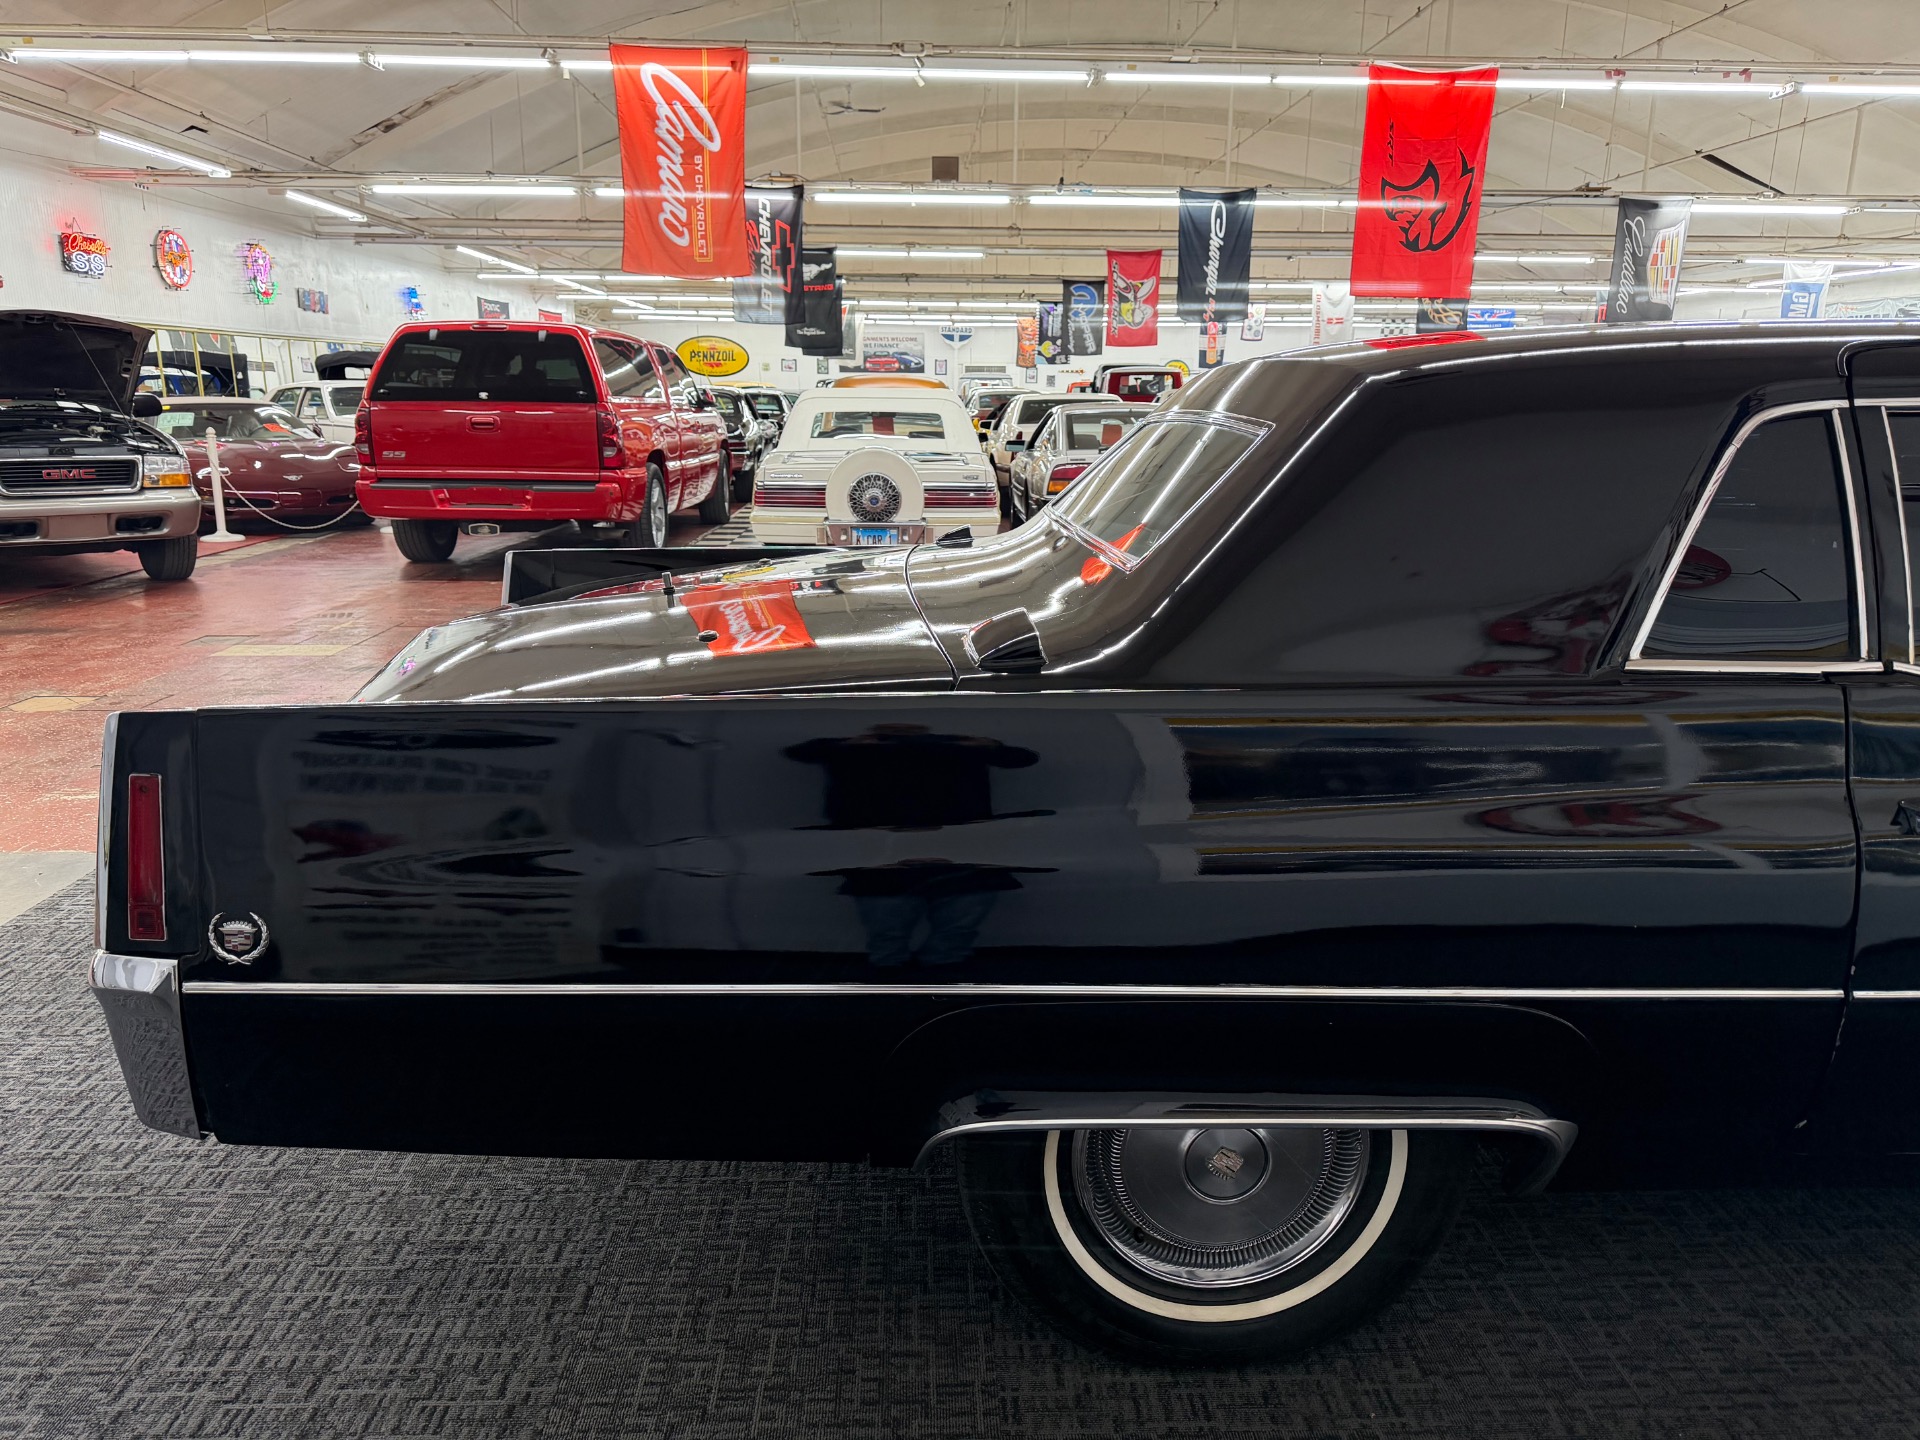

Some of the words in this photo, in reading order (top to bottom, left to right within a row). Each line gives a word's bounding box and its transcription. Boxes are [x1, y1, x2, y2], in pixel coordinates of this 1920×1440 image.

[640, 62, 721, 247] Camaro
[694, 155, 703, 171] BY
[694, 171, 707, 256] CHEVROLET
[68, 233, 107, 255] Chevelle
[165, 233, 183, 246] FORD
[1203, 199, 1227, 296] Charger
[71, 250, 106, 274] SS
[758, 197, 773, 316] CHEVROLET
[1615, 216, 1646, 314] Cadillac
[802, 283, 834, 292] STANG
[1111, 258, 1120, 297] SCAT
[1077, 302, 1098, 354] MOPAR
[1111, 296, 1120, 338] PACK
[1313, 294, 1322, 346] OLDSMOBILE
[940, 326, 973, 334] STANDARD
[689, 350, 736, 361] PENNZOIL
[382, 450, 406, 458] SS
[41, 468, 97, 480] GMC
[856, 534, 862, 545] K
[866, 534, 883, 545] CAR
